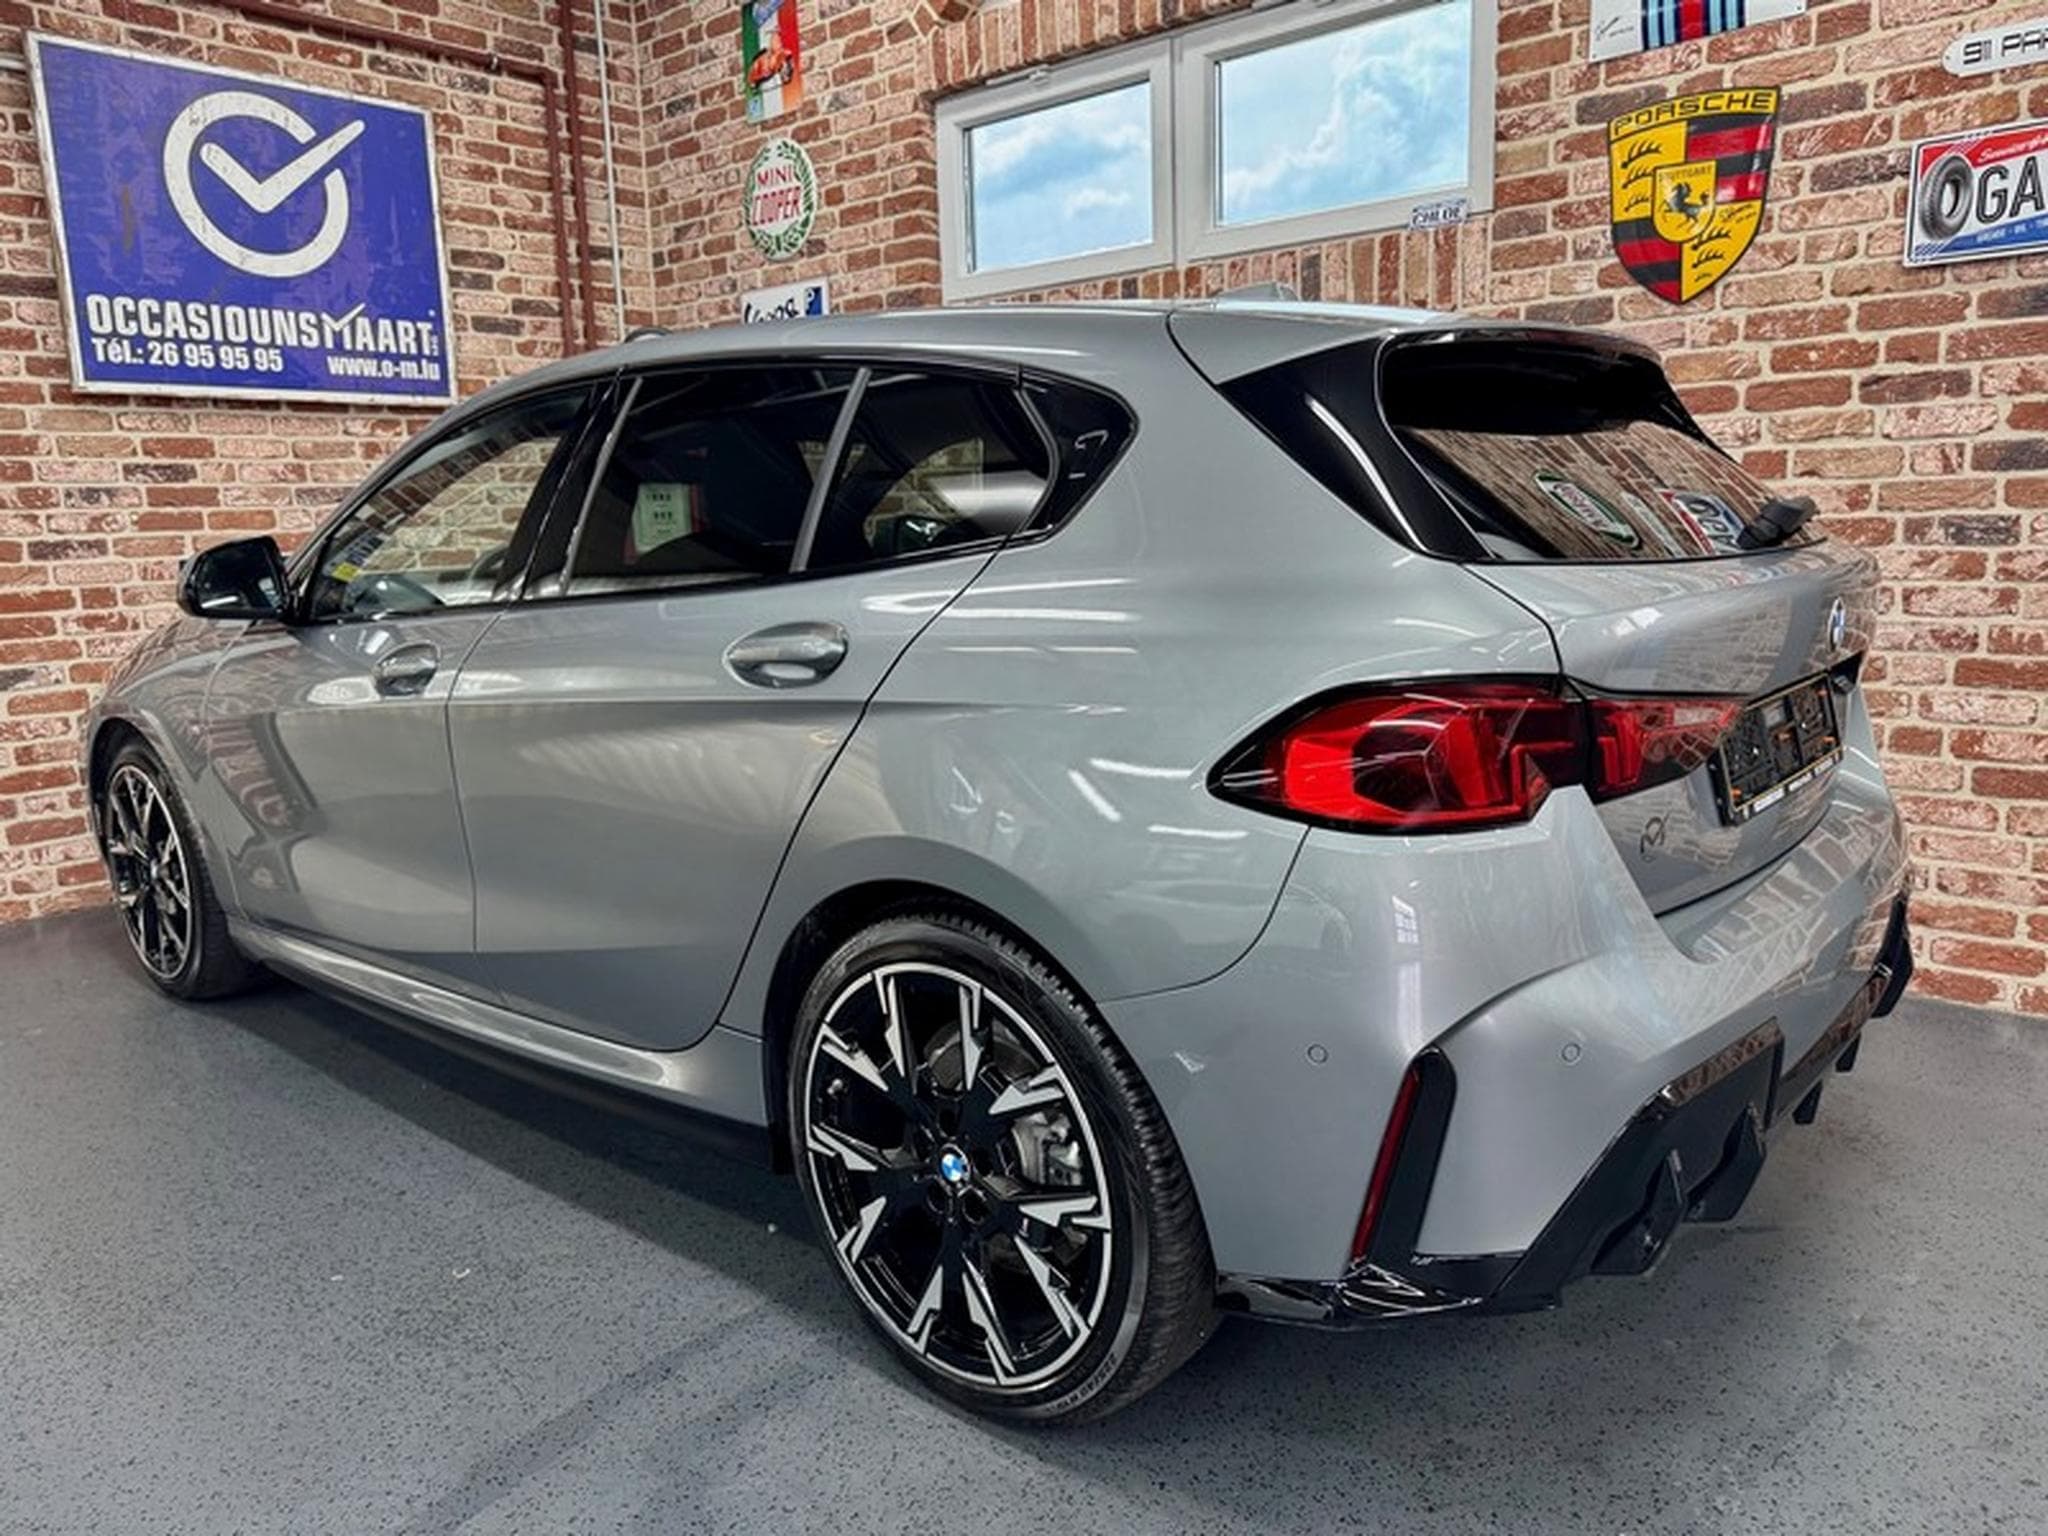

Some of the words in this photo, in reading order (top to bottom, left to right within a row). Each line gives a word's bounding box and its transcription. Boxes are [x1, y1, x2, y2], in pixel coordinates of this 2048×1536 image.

[1614, 92, 1773, 136] PORSCHE
[757, 164, 792, 187] MINI
[752, 186, 801, 226] COOPER
[147, 341, 180, 366] 26
[183, 342, 215, 368] 95
[219, 344, 251, 370] 95
[253, 347, 284, 372] 95
[327, 355, 440, 380] www.o-m.lu
